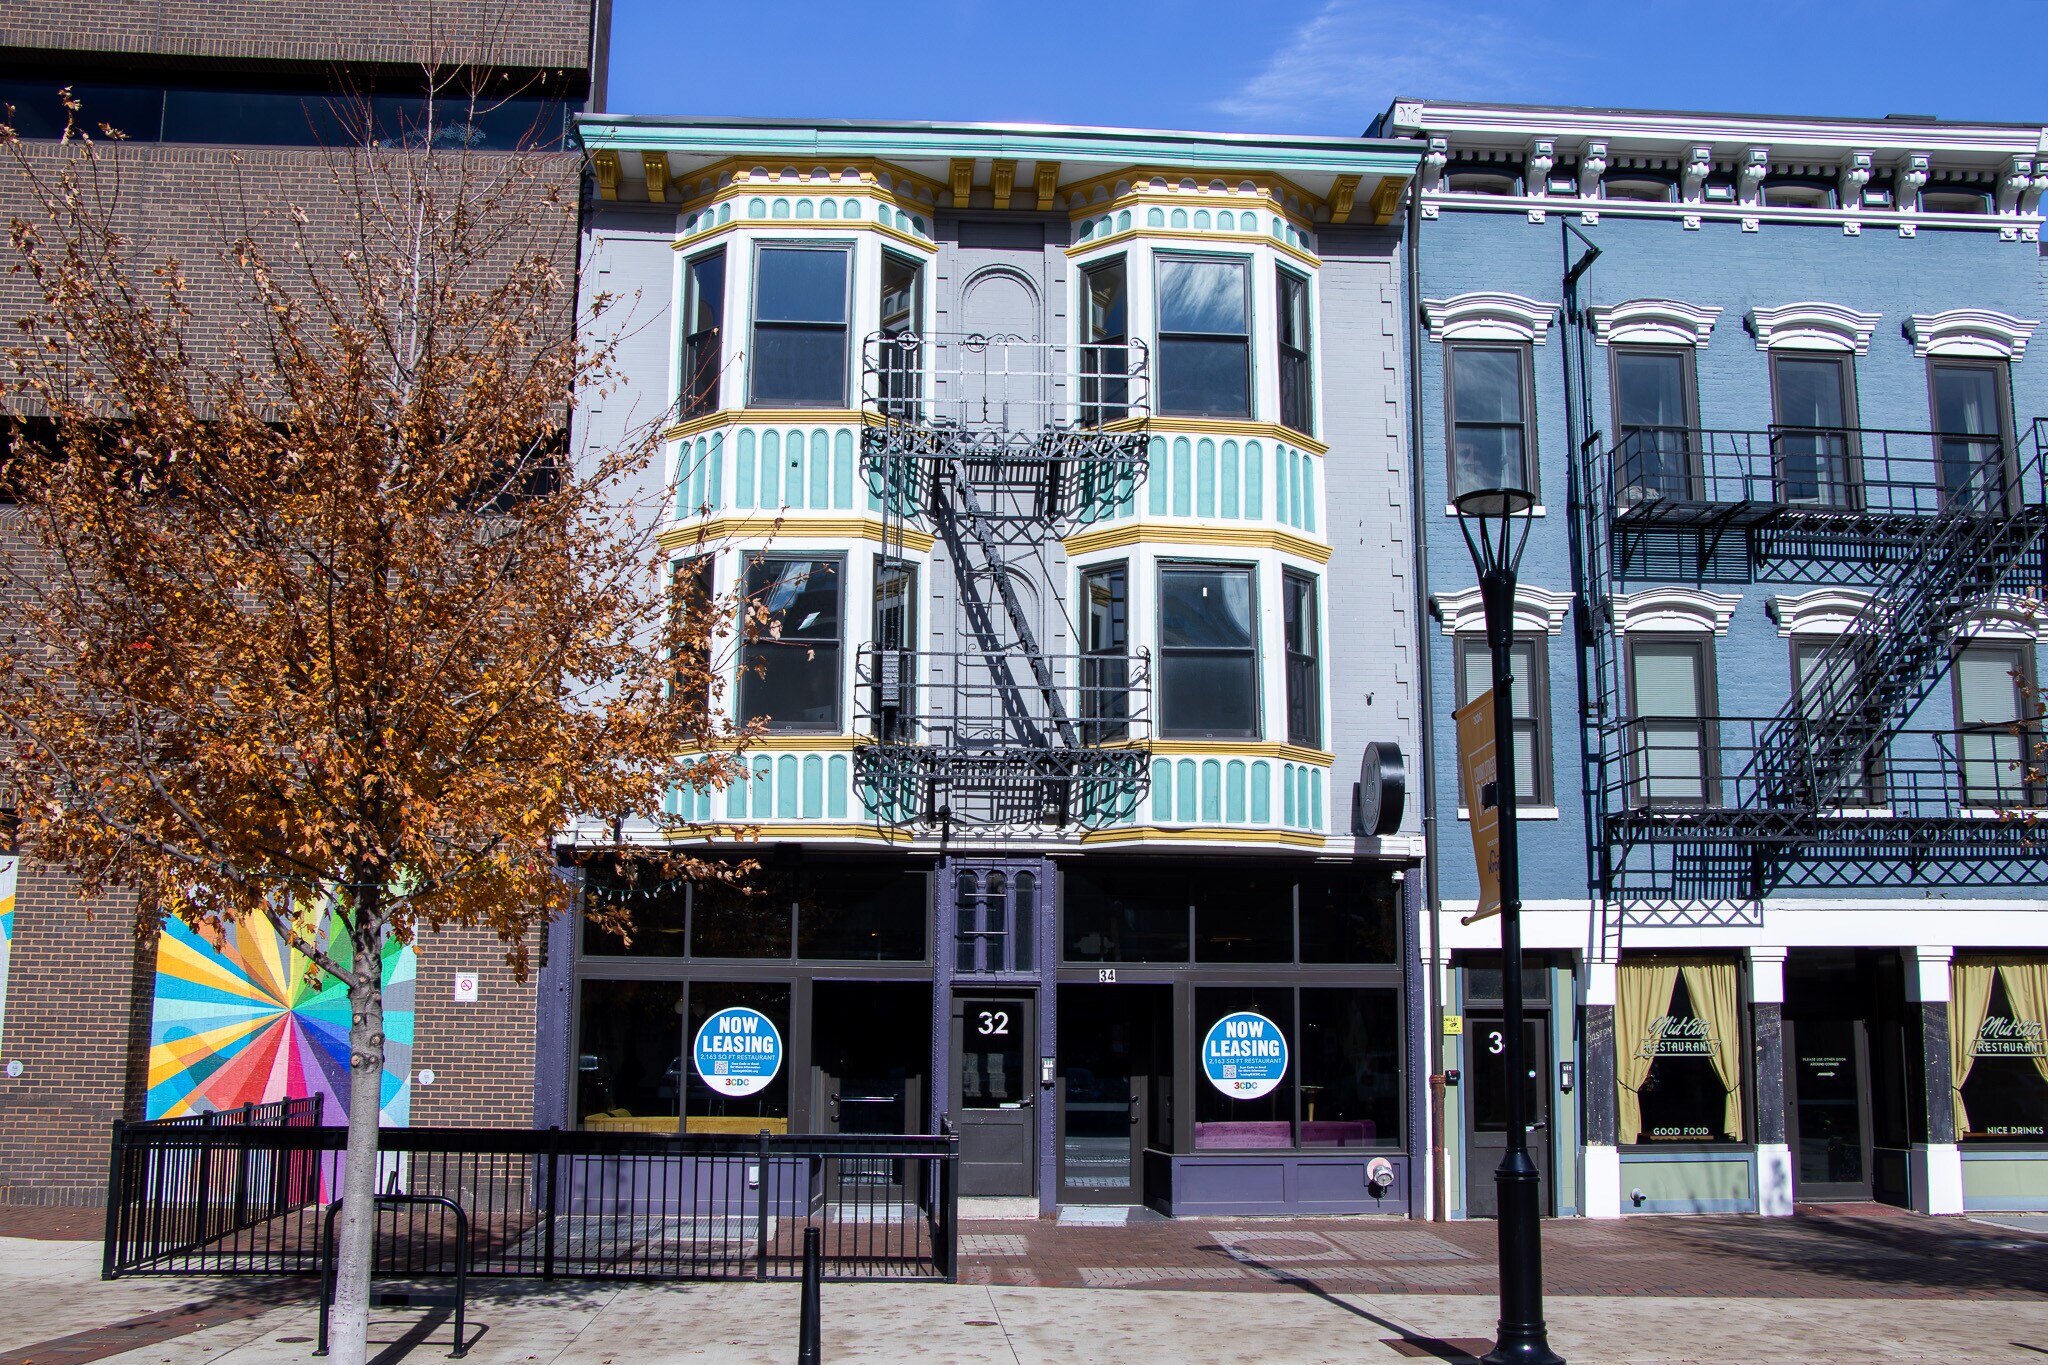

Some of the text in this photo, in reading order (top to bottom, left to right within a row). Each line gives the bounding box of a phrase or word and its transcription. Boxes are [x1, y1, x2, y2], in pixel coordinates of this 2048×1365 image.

[1100, 970, 1114, 981] 34
[719, 1016, 759, 1034] NOW
[978, 1011, 1009, 1035] 32
[1226, 1021, 1264, 1038] NOW
[1648, 1015, 1711, 1039] Mid-City
[1981, 1016, 2042, 1040] Mid-City
[702, 1035, 774, 1053] LEASING
[1210, 1040, 1280, 1057] LEASING
[1645, 1041, 1711, 1052] RESTAURANT
[1978, 1041, 2043, 1052] RESTAURANT
[725, 1078, 749, 1086] 3CDC
[1653, 1127, 1709, 1136] GOOD FOOD
[1987, 1126, 2044, 1135] NICE DRINKS
